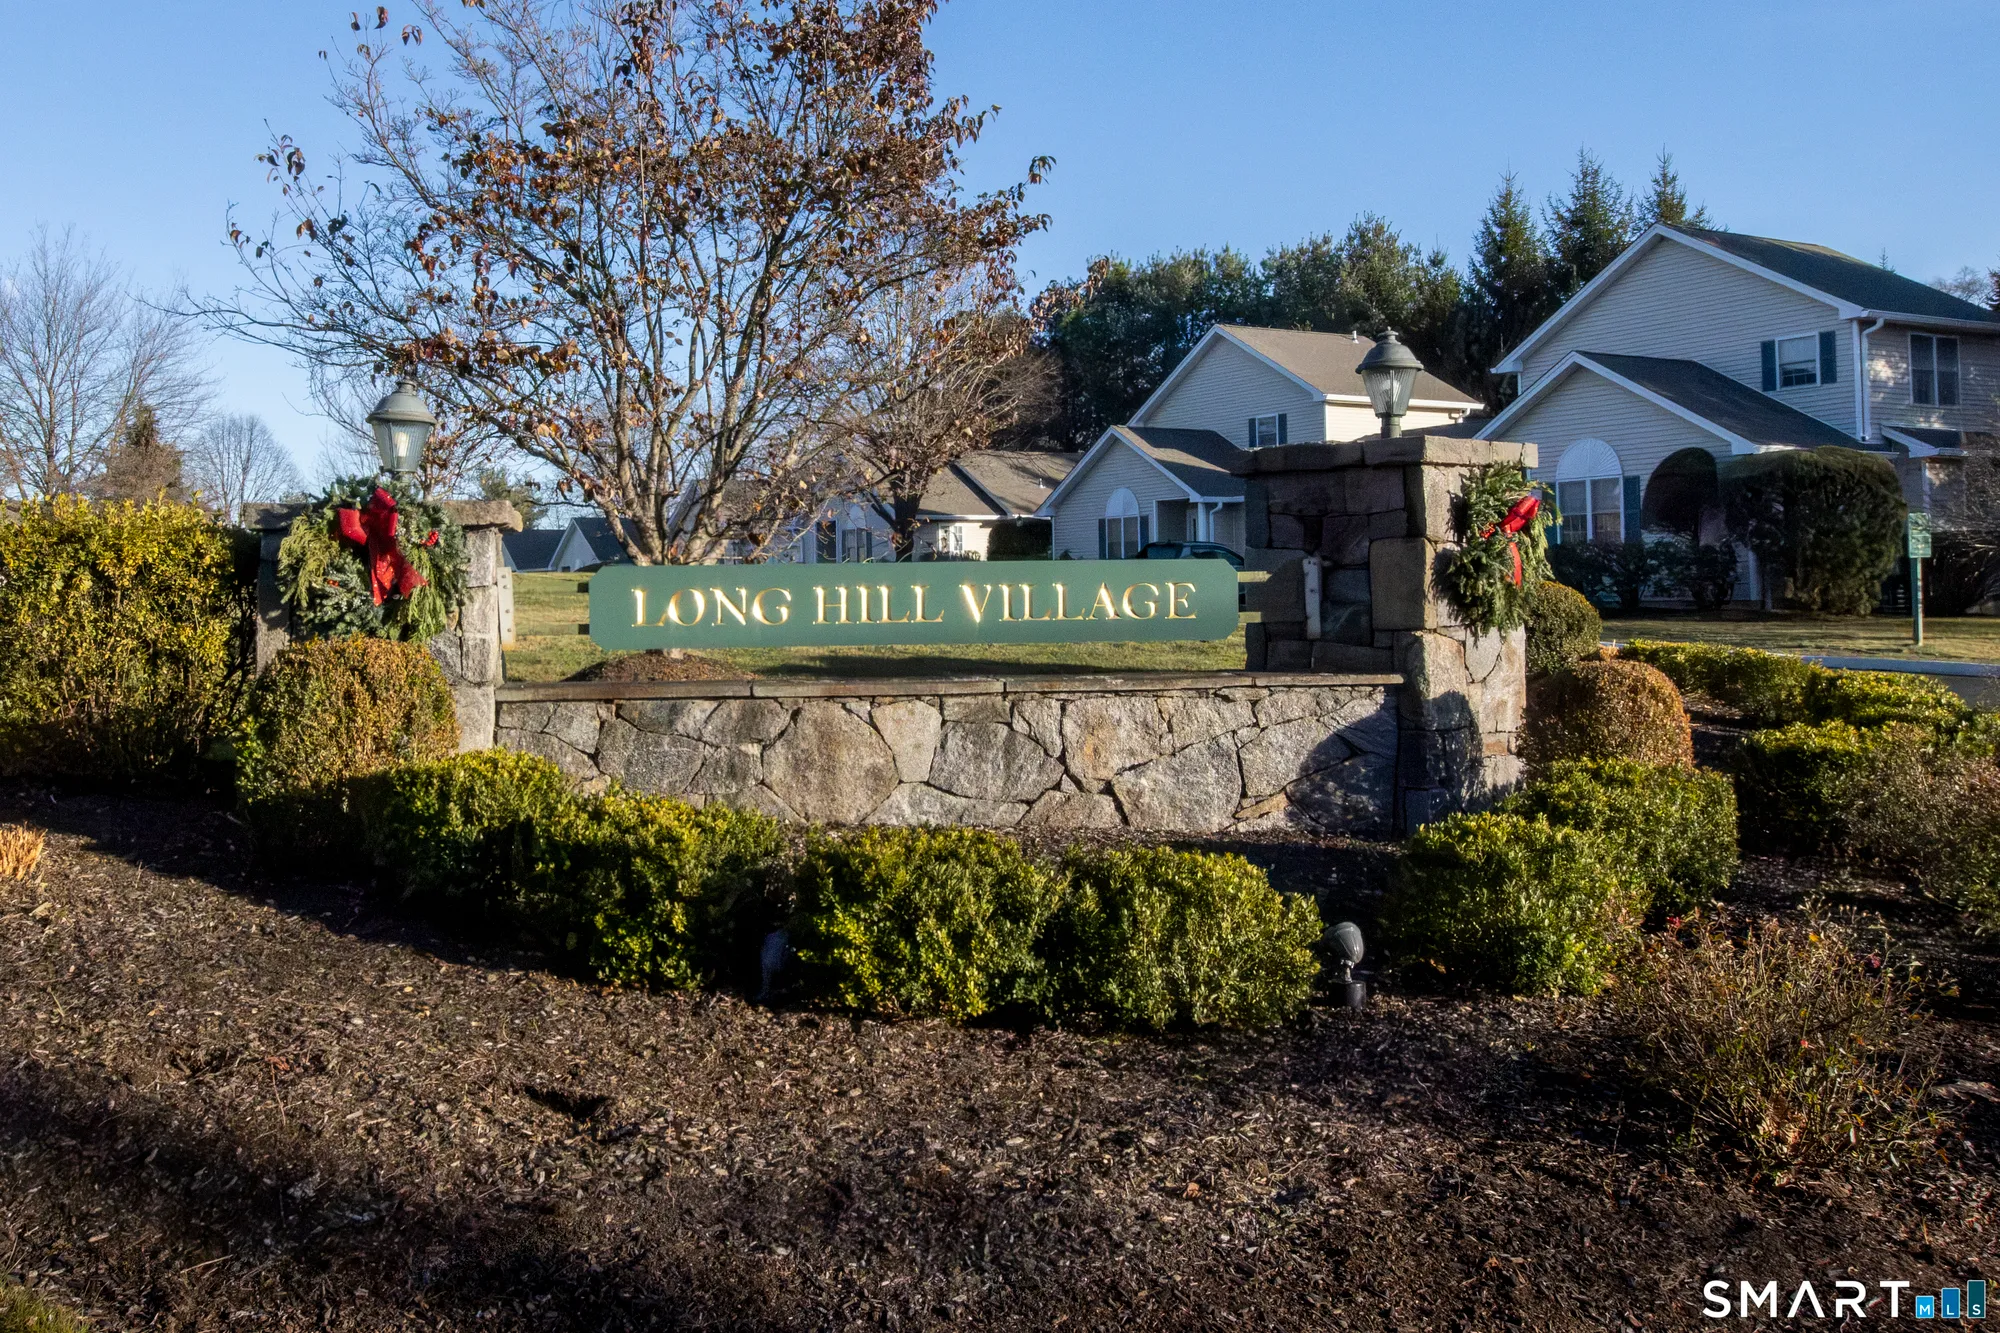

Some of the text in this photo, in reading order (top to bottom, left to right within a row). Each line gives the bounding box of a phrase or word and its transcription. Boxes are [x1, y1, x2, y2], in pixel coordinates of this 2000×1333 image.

[632, 581, 1197, 627] LONG HILL VILLAGE
